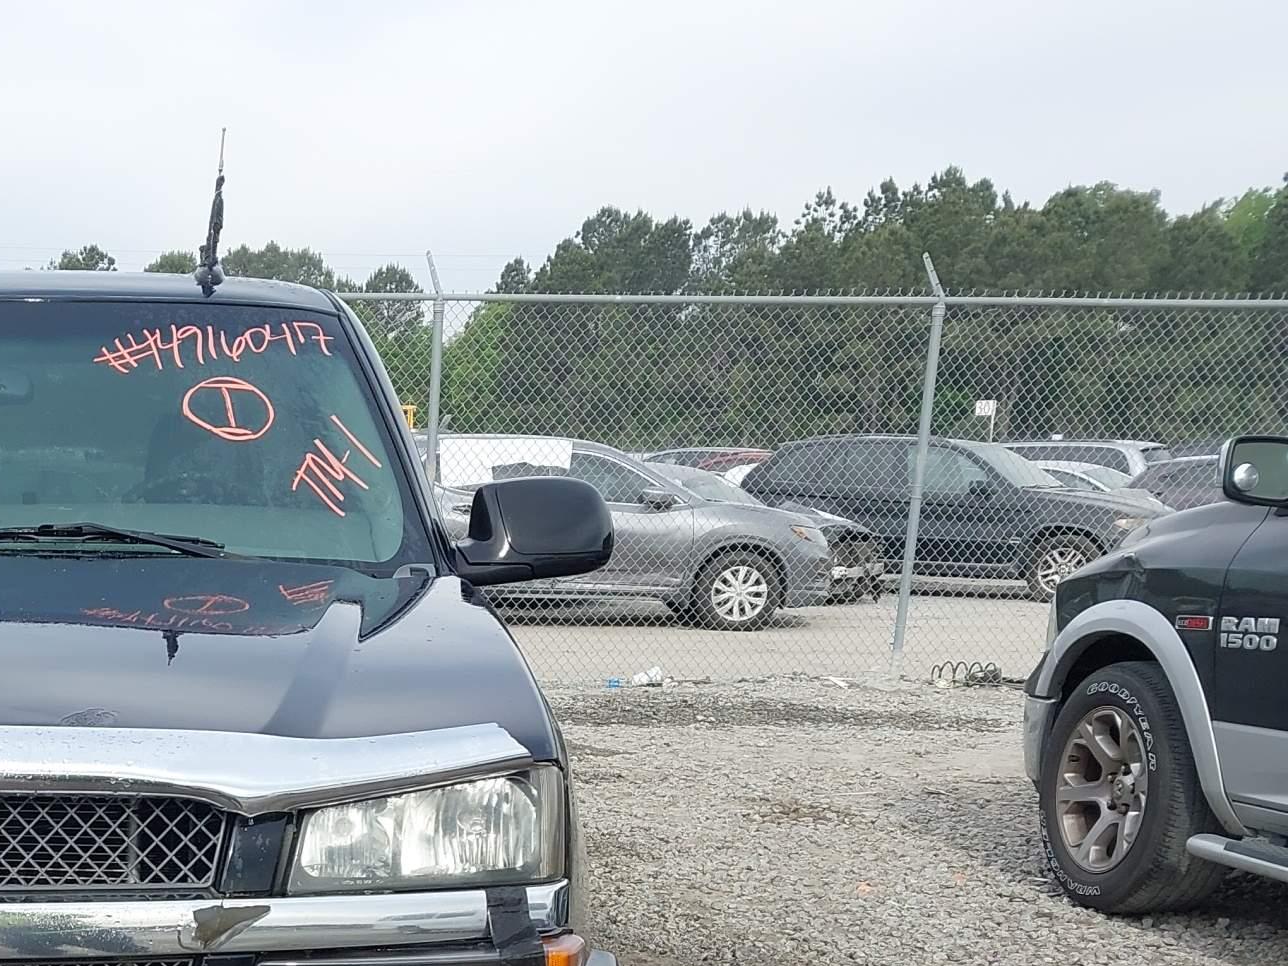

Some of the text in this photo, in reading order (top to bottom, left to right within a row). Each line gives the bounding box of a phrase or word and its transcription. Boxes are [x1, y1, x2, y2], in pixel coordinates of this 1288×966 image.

[1221, 616, 1281, 634] RAM
[1220, 633, 1278, 651] 1500
[1087, 682, 1156, 771] GOODYEAR
